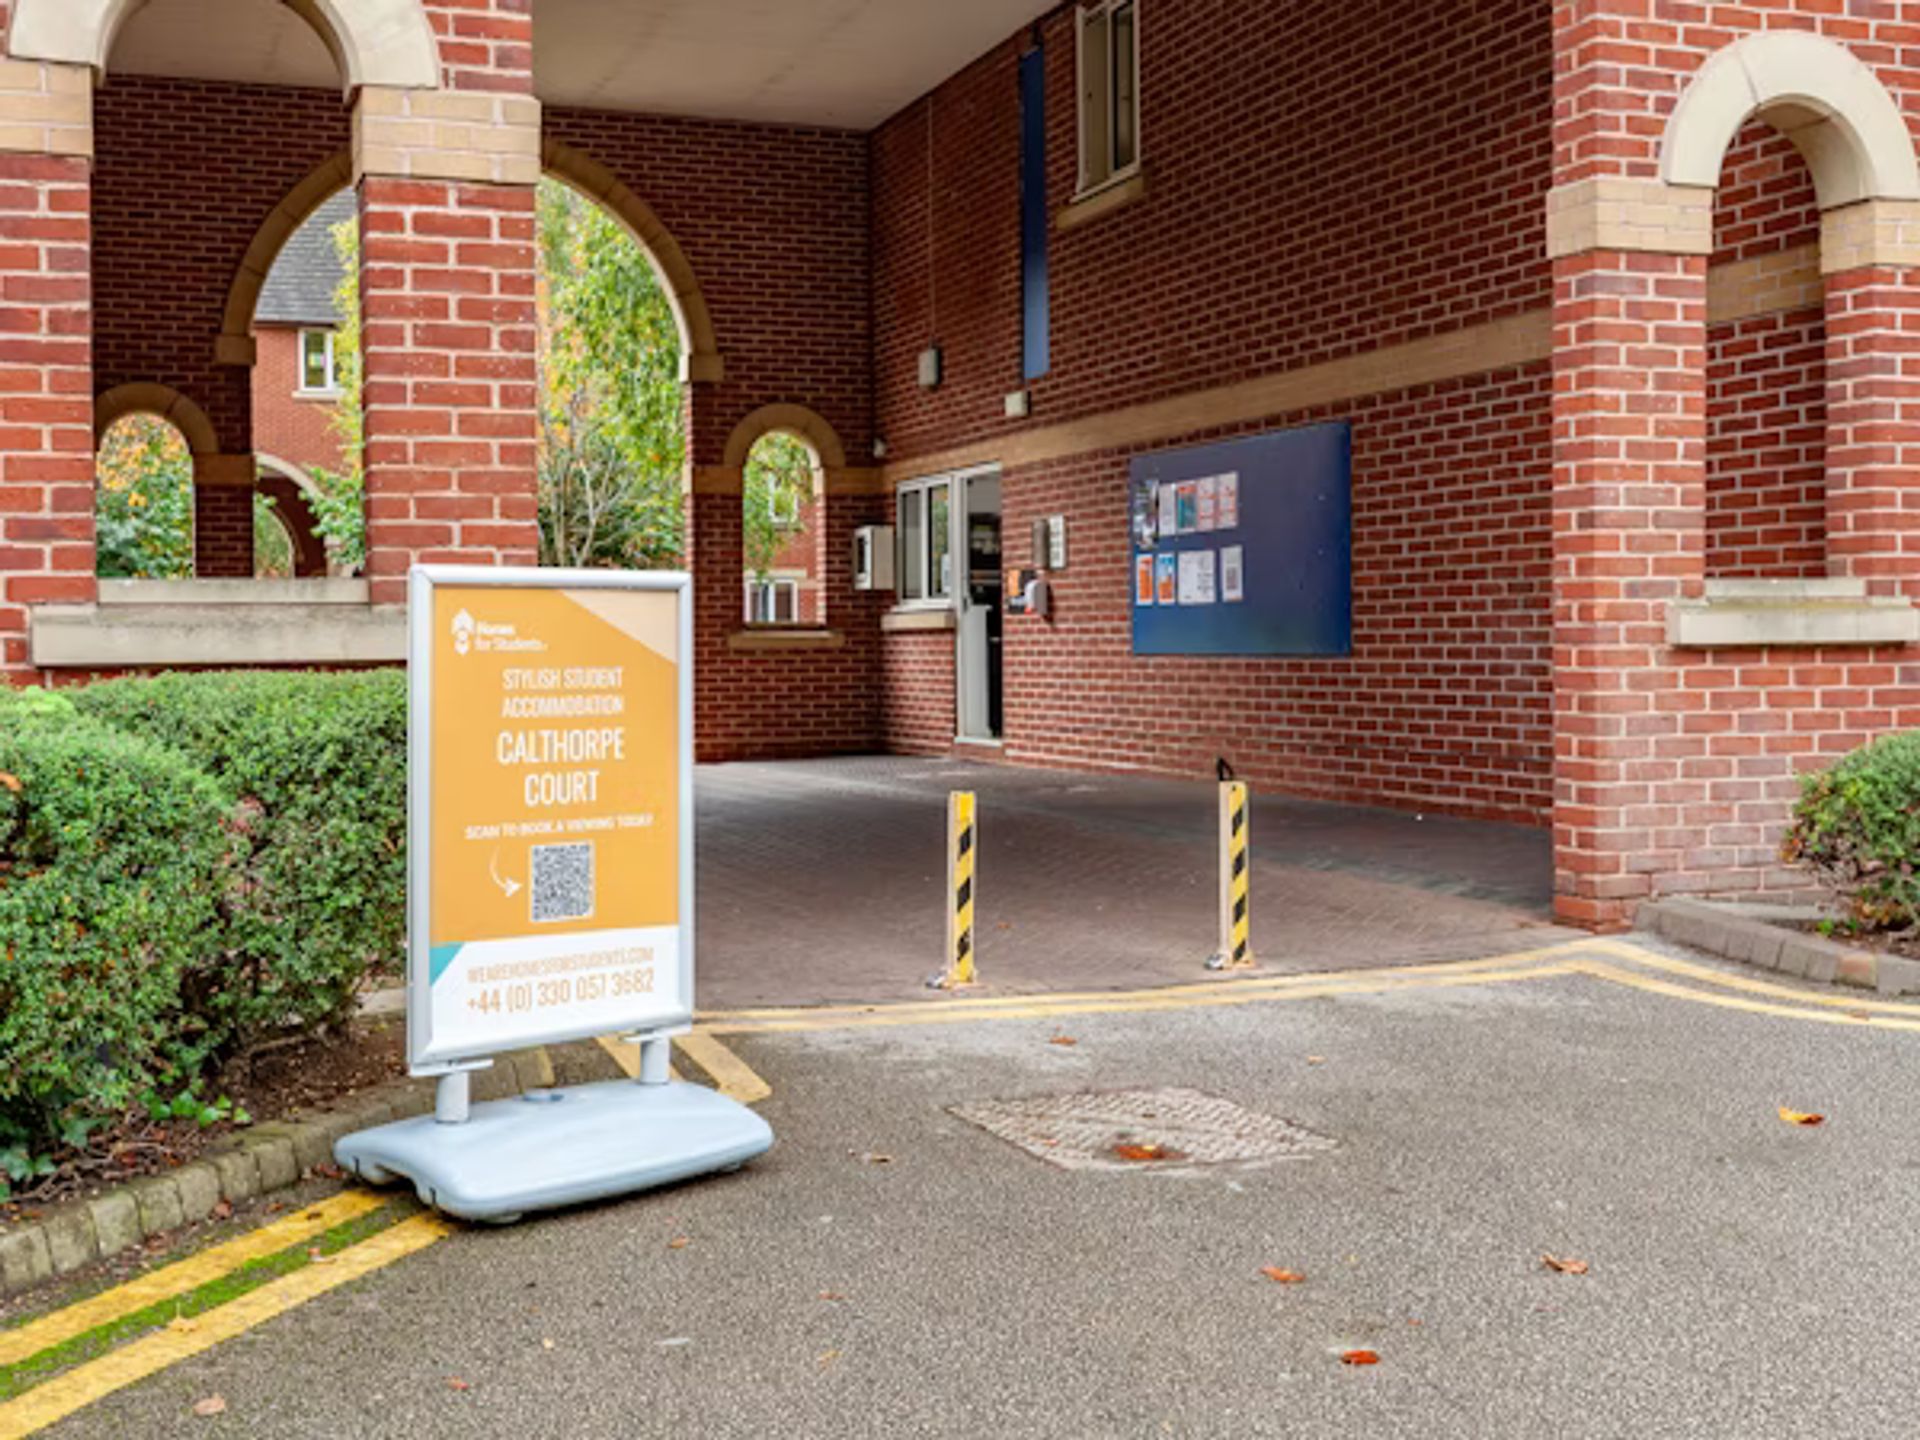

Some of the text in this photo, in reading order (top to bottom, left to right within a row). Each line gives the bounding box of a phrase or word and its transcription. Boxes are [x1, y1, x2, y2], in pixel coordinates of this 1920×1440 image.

[502, 665, 623, 690] STYLISH STUDENT
[502, 694, 624, 718] ACCOMMODATION
[497, 727, 625, 764] CALTHORPE
[524, 769, 599, 807] COURT
[465, 824, 500, 840] SCAN
[502, 821, 518, 837] TO
[520, 819, 552, 836] BOOK
[555, 820, 565, 833] A
[567, 816, 614, 832] VIEWING
[467, 988, 501, 1013] +44
[506, 983, 532, 1012] (0)
[537, 979, 571, 1007] 330
